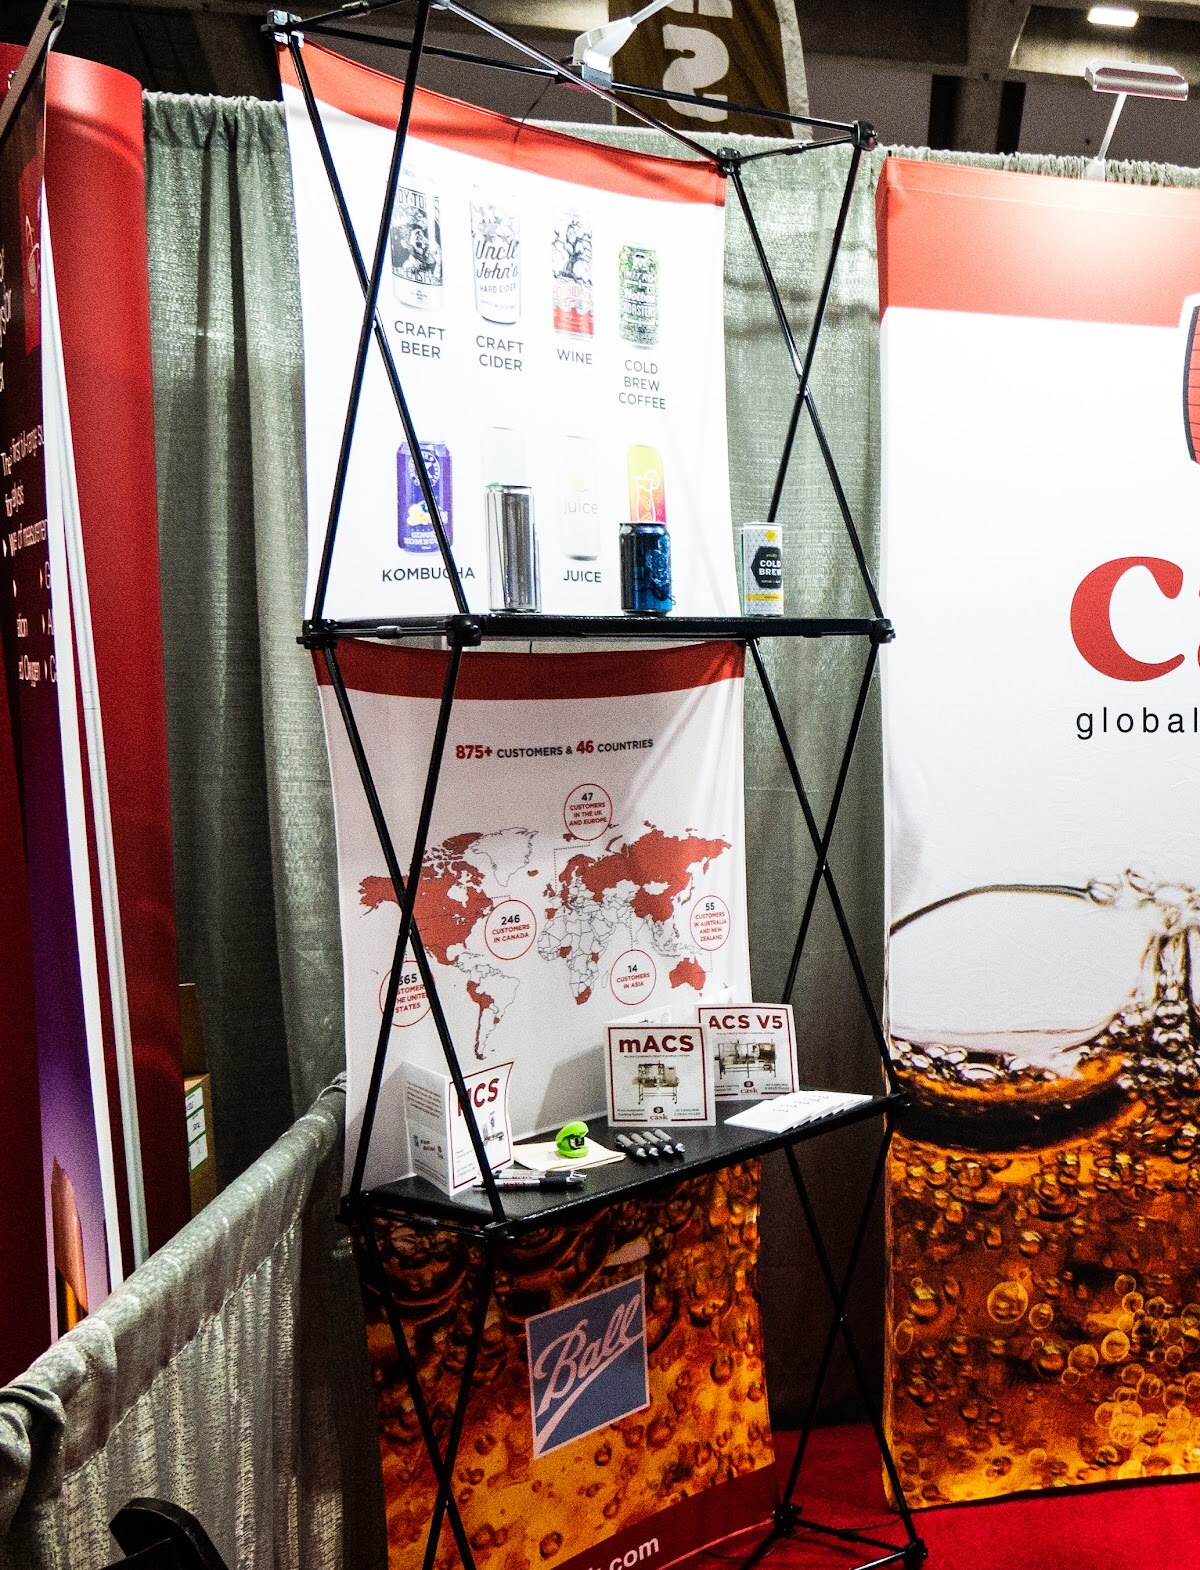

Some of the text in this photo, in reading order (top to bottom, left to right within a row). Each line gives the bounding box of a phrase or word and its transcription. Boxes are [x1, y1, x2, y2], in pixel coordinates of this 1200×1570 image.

[394, 320, 446, 341] CRAFT
[400, 341, 441, 359] BEER
[476, 335, 524, 354] CRAFT
[479, 354, 523, 371] CIDER
[557, 349, 593, 365] WINE
[624, 359, 658, 375] COLD
[624, 376, 660, 392] BREW
[618, 392, 666, 410] COFFEE
[564, 498, 600, 515] juice
[760, 560, 781, 568] COLD
[563, 570, 602, 583] JUICE
[1076, 707, 1199, 740] global
[455, 738, 654, 759] 875+ CUSTOMERS & 46 COUNTRIES
[581, 792, 594, 801] 47
[569, 801, 606, 811] CUSTOMERS
[583, 816, 607, 825] EUROPE
[705, 902, 715, 911] 55
[501, 915, 520, 925] 246
[695, 912, 725, 920] CUSTOMERS
[491, 924, 530, 935] CUSTOMERS
[502, 932, 529, 942] CANADA
[628, 964, 638, 973] 14
[616, 972, 650, 983] CUSTOMERS
[407, 992, 427, 1002] UNITE
[395, 1003, 420, 1013] STATES
[709, 1014, 783, 1030] ACS V5
[619, 1035, 694, 1053] mACS
[533, 1294, 645, 1418] Ball
